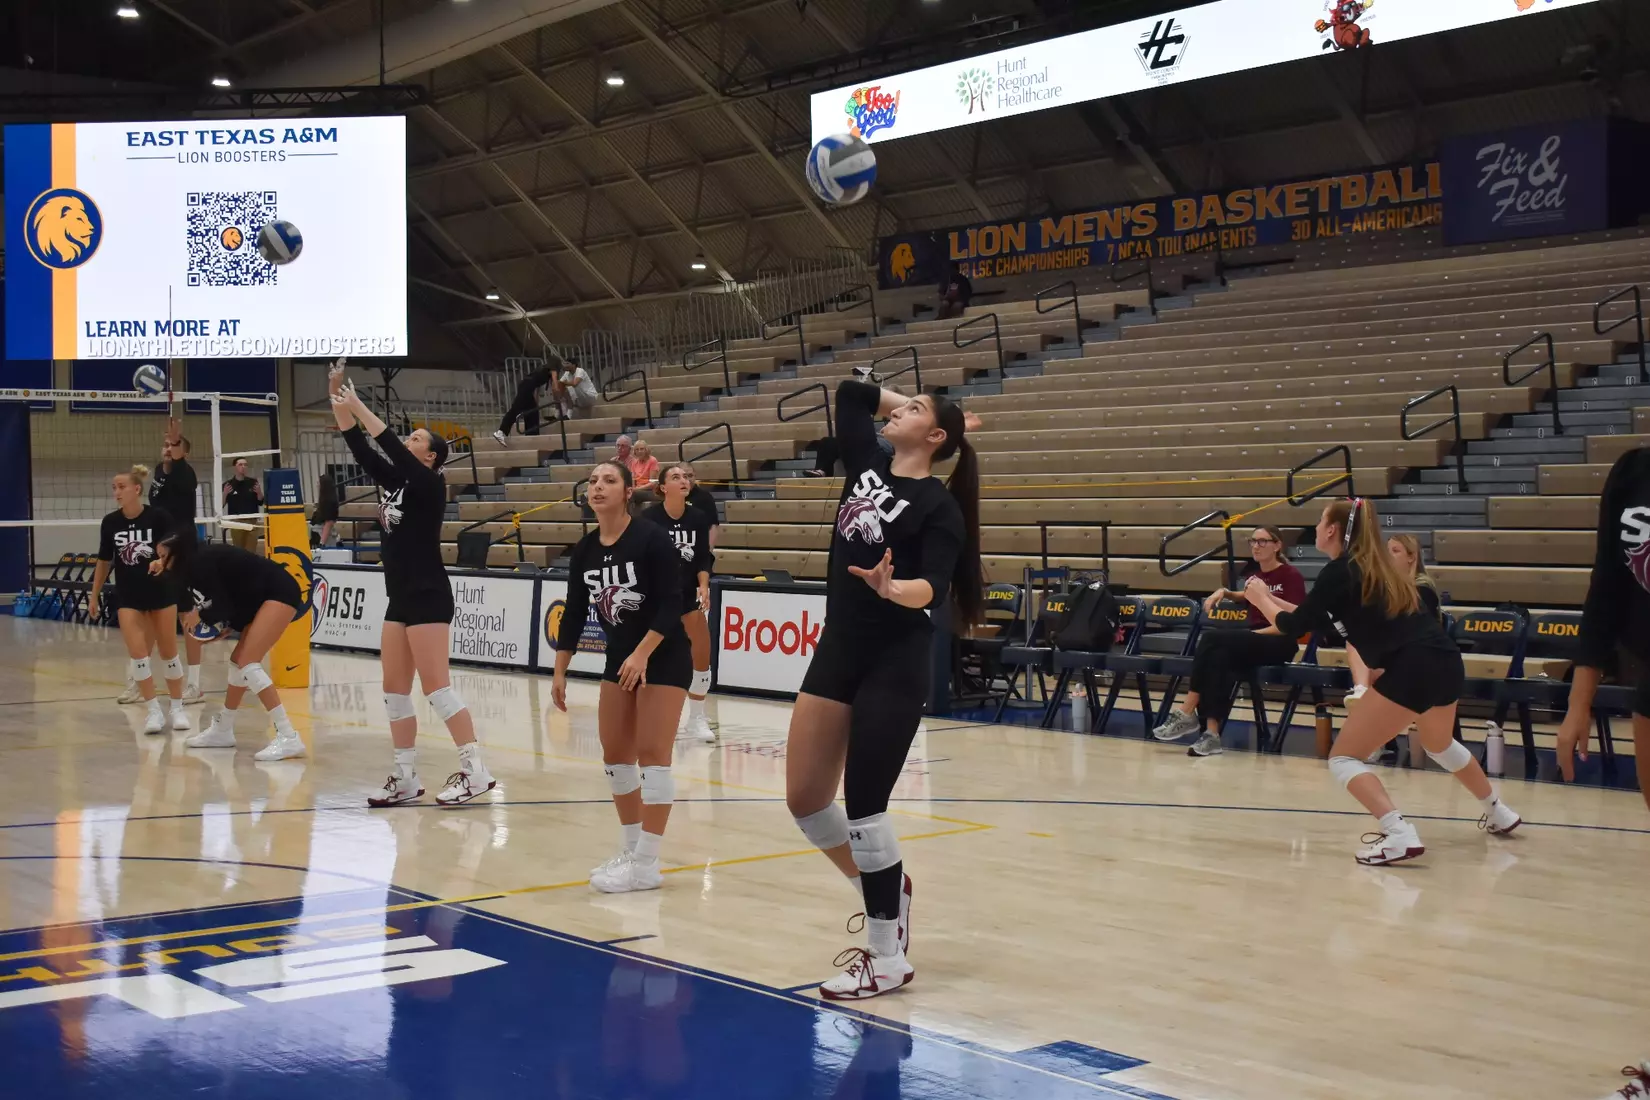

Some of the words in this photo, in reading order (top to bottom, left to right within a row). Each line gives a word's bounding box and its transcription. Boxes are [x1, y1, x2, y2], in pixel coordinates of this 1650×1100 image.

[997, 56, 1026, 75] Hunt
[997, 66, 1048, 94] Regional
[865, 86, 894, 112] Too
[998, 86, 1062, 109] Healthcare
[126, 130, 189, 147] EAST
[195, 128, 275, 145] TEXAS
[282, 127, 338, 144] A&M
[177, 151, 209, 164] LION
[214, 150, 287, 163] BOOSTERS
[1476, 142, 1528, 188] Fix
[1528, 135, 1560, 187] &
[1489, 173, 1568, 222] Feed
[949, 222, 1027, 260] LION
[1040, 202, 1158, 248] MEN'S
[972, 259, 993, 280] LSC
[996, 247, 1089, 276] CHAMPIONSHIPS
[1107, 244, 1115, 262] 7
[1291, 219, 1312, 241] 30
[85, 320, 147, 338] LEARN
[154, 319, 210, 337] MORE
[218, 319, 241, 336] AT
[86, 335, 396, 358] LIONATHLETICS.COM/BOOSTERS
[851, 469, 911, 523] SIU
[114, 528, 153, 547] SIU
[583, 561, 638, 594] SIU
[327, 586, 366, 620] ASG
[455, 581, 485, 605] Hunt
[989, 591, 1015, 600] IONS
[453, 607, 506, 637] Regional
[1152, 605, 1191, 617] LIONS
[1207, 608, 1248, 620] LIONS
[724, 606, 825, 656] Brook
[1463, 620, 1514, 633] LIONS
[1537, 622, 1579, 636] LION
[452, 632, 518, 660] Healthcare
